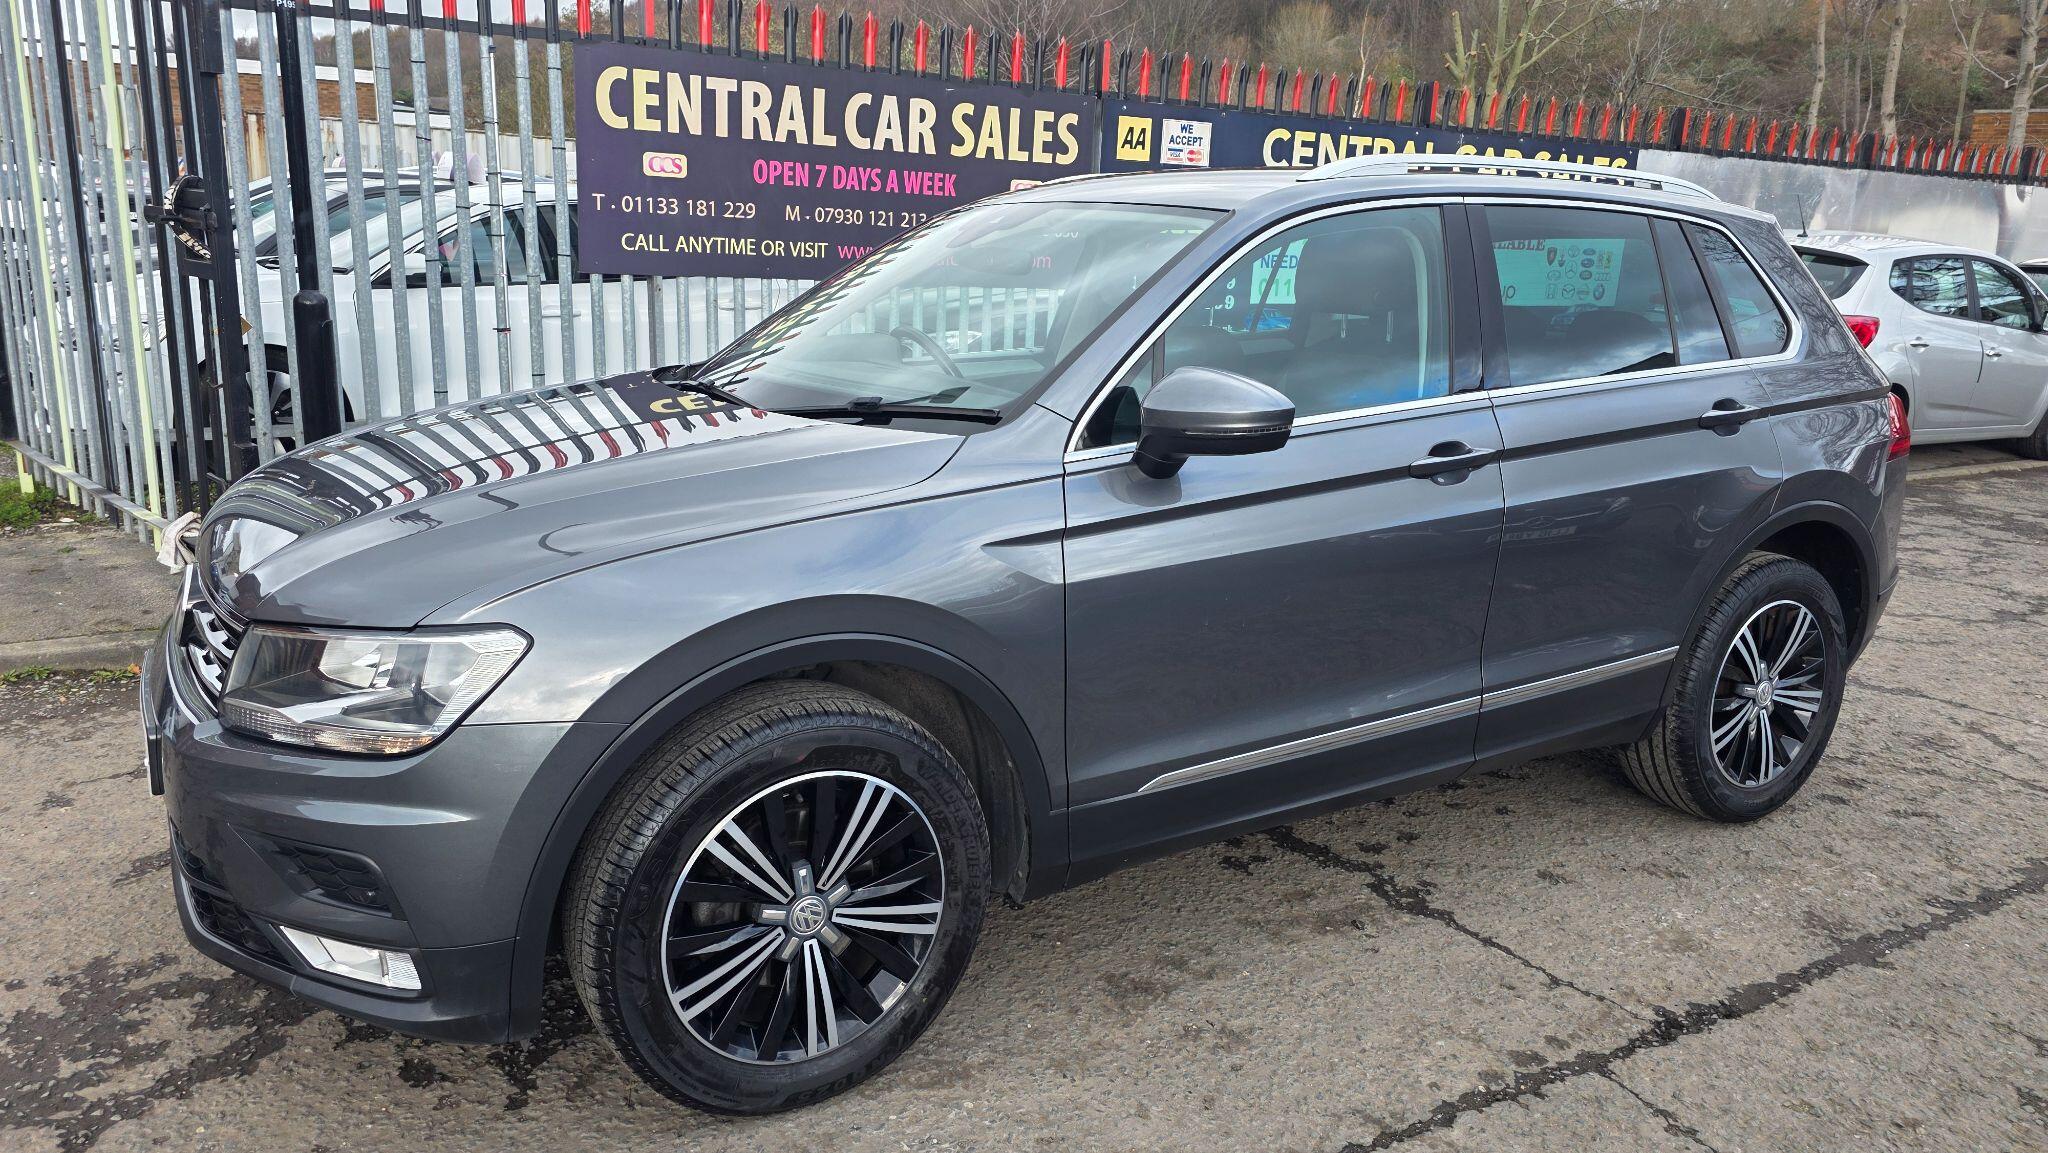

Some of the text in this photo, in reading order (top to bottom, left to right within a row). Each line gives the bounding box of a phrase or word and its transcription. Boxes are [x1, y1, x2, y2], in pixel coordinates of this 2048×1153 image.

[595, 65, 1079, 165] CENTRAL CAR SALES
[1121, 126, 1147, 150] AA
[1180, 123, 1194, 134] WE
[1168, 134, 1204, 147] ACCEPT
[648, 155, 683, 174] CCS
[752, 159, 957, 197] OPEN 7 DAYS A WEEK
[621, 196, 679, 215] 01133
[686, 199, 715, 217] 181
[723, 202, 756, 219] 229
[814, 207, 863, 225] 07930
[869, 211, 894, 227] 121
[621, 233, 670, 252] CALL
[675, 236, 757, 256] ANYTIME
[761, 240, 785, 257] OR
[789, 242, 829, 259] VISIT
